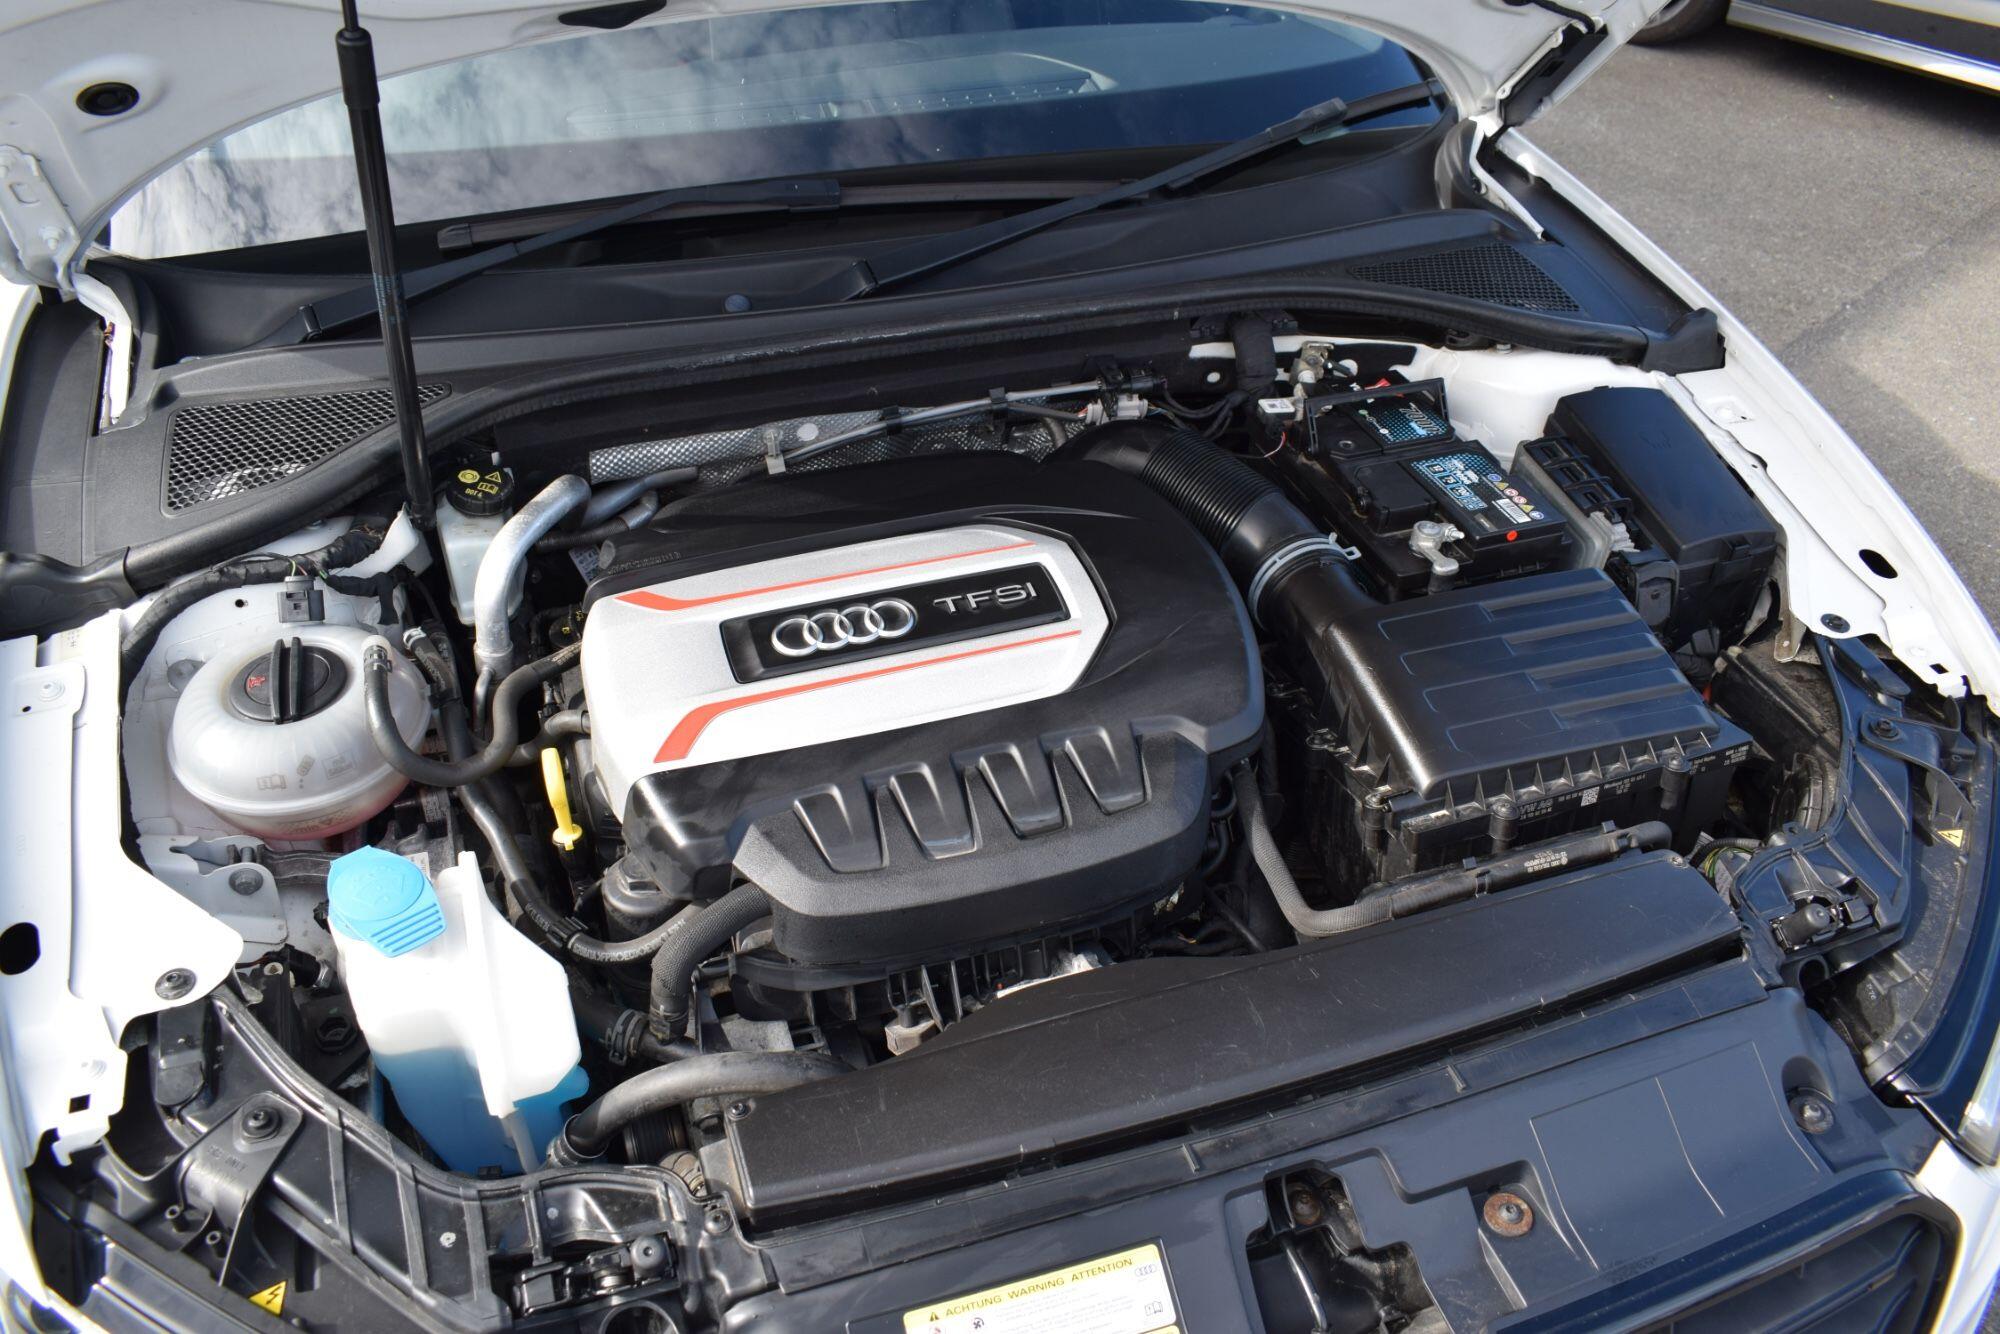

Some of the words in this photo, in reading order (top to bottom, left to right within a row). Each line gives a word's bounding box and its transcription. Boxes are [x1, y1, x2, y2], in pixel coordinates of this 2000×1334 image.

[933, 582, 1037, 614] TFSI
[945, 1295, 1002, 1317] ACHTUNG
[1008, 1277, 1065, 1299] WARNING
[1071, 1258, 1133, 1282] ATTENTION
